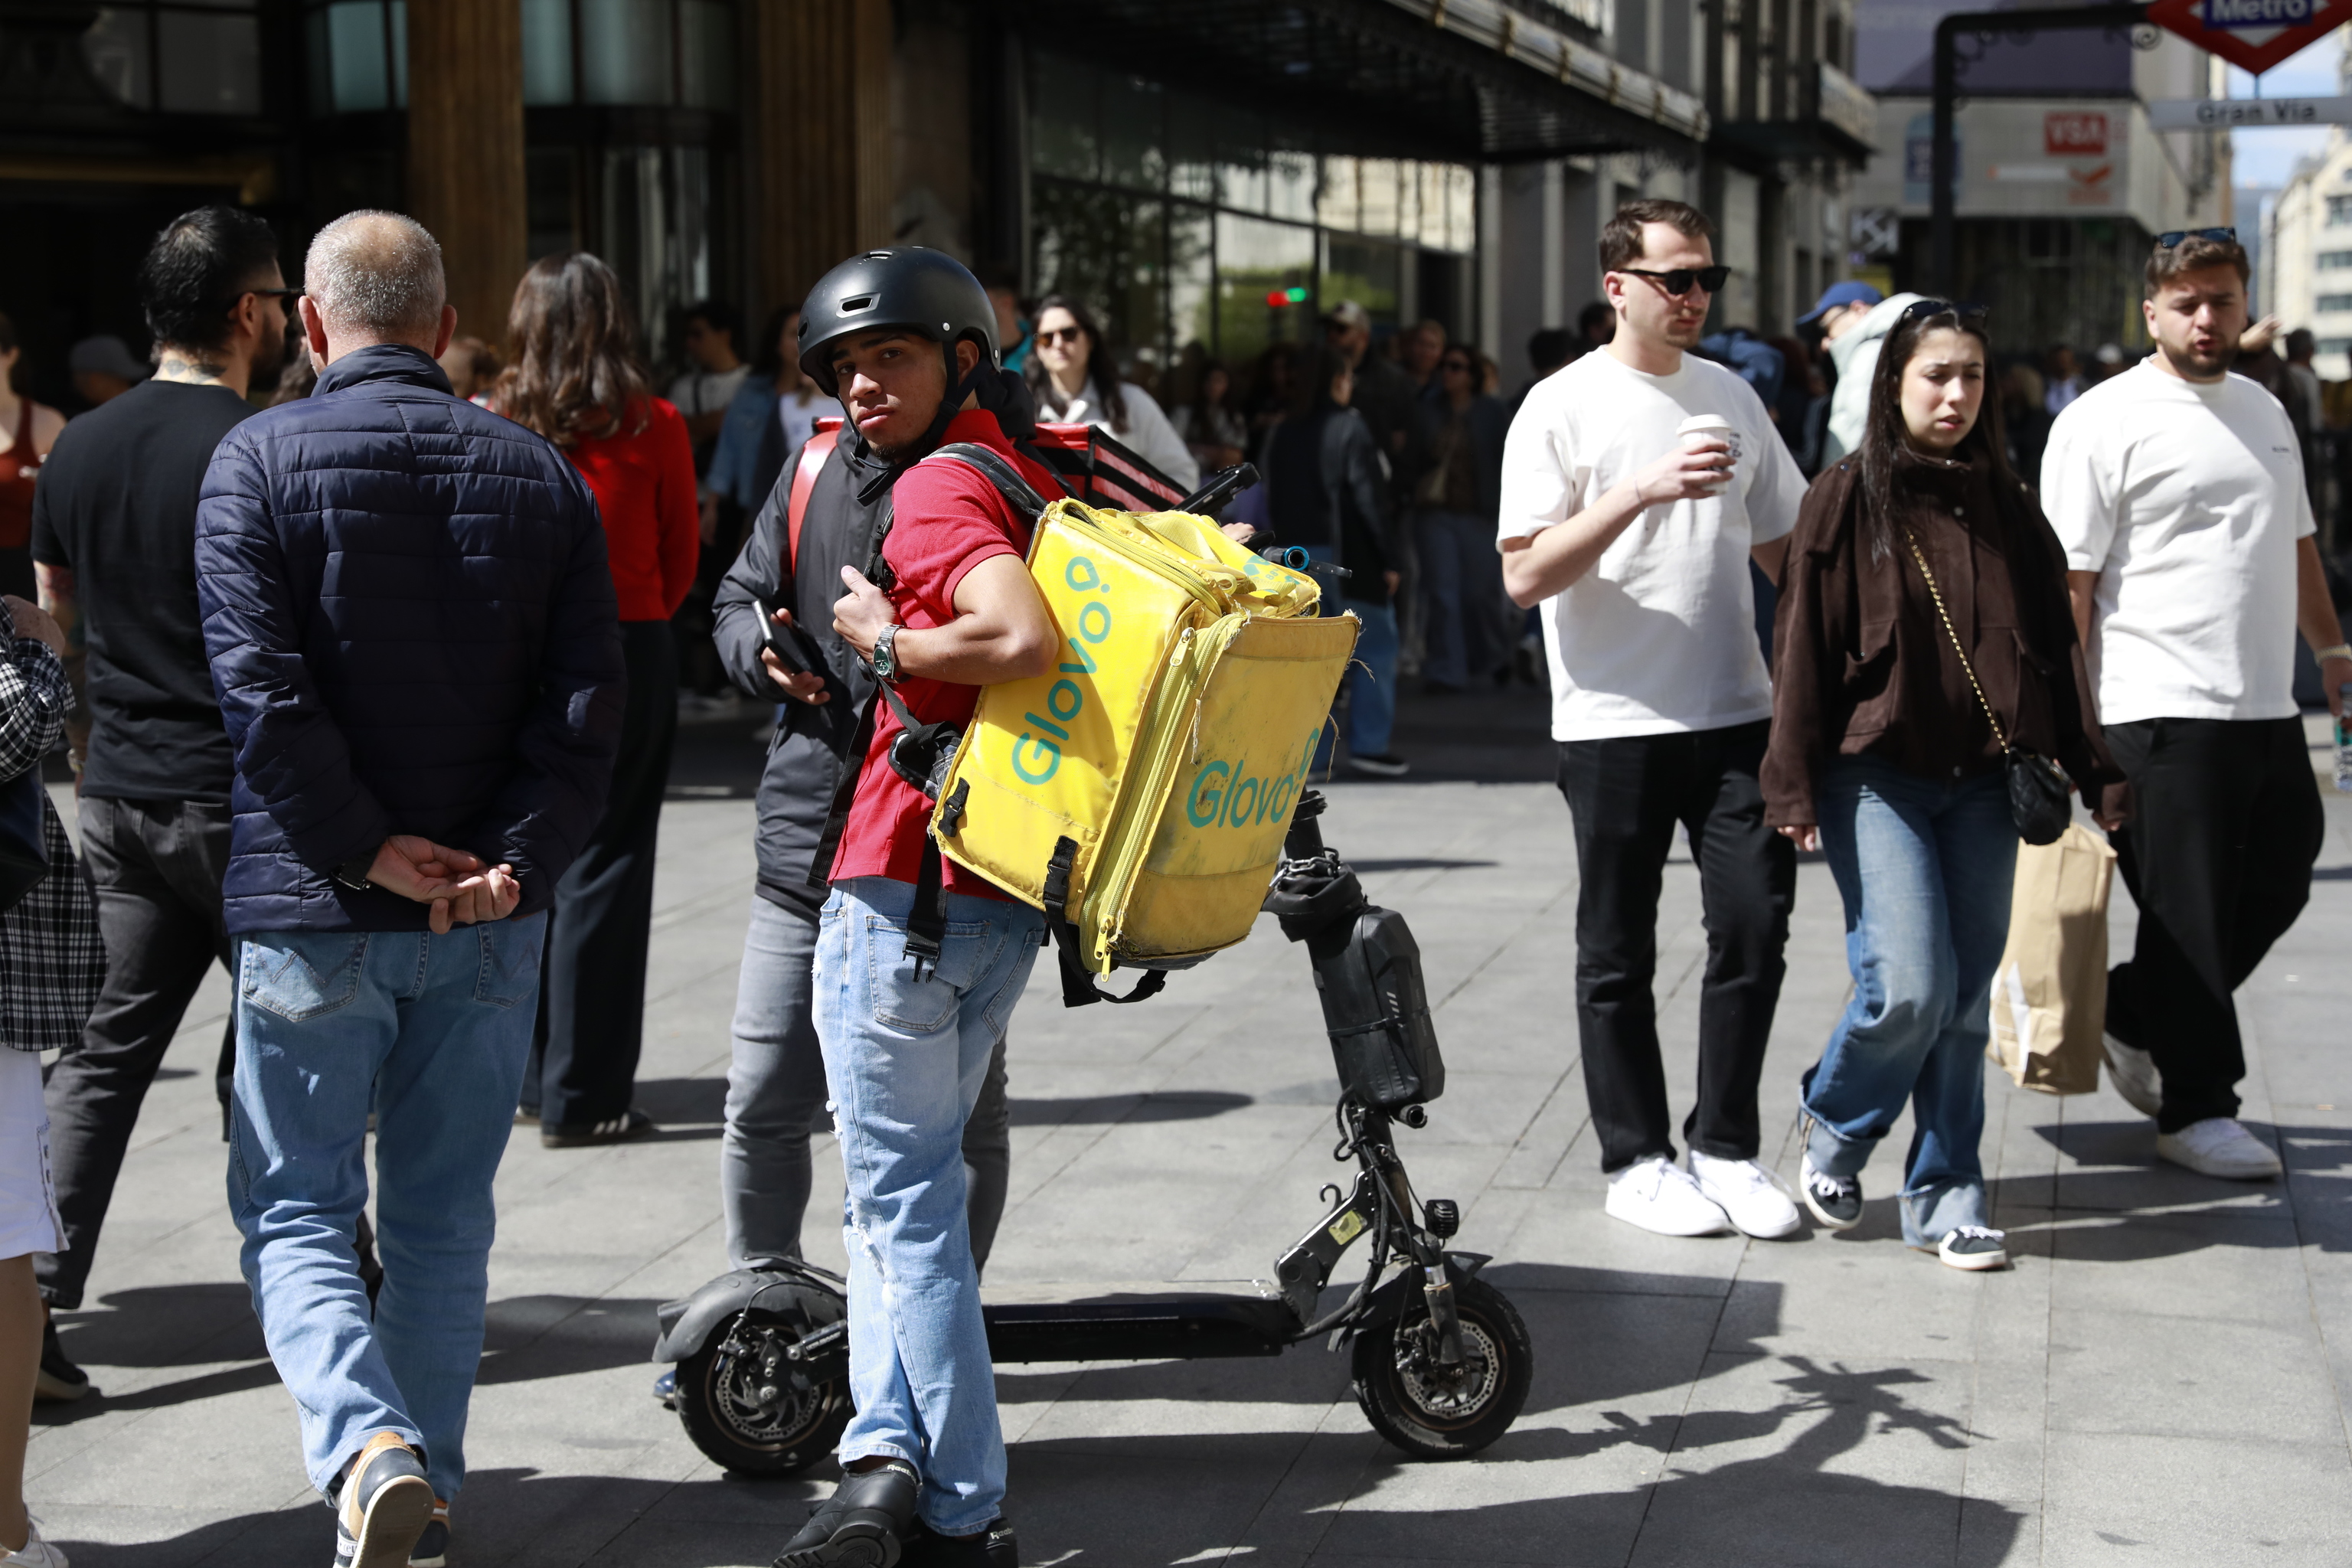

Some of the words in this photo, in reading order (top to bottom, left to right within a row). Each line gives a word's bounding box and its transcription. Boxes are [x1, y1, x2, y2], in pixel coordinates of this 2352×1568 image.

[2211, 0, 2308, 21] Metro
[2196, 101, 2264, 124] Gran
[1011, 602, 1112, 786] Glovo
[1187, 759, 1295, 828] Glovo
